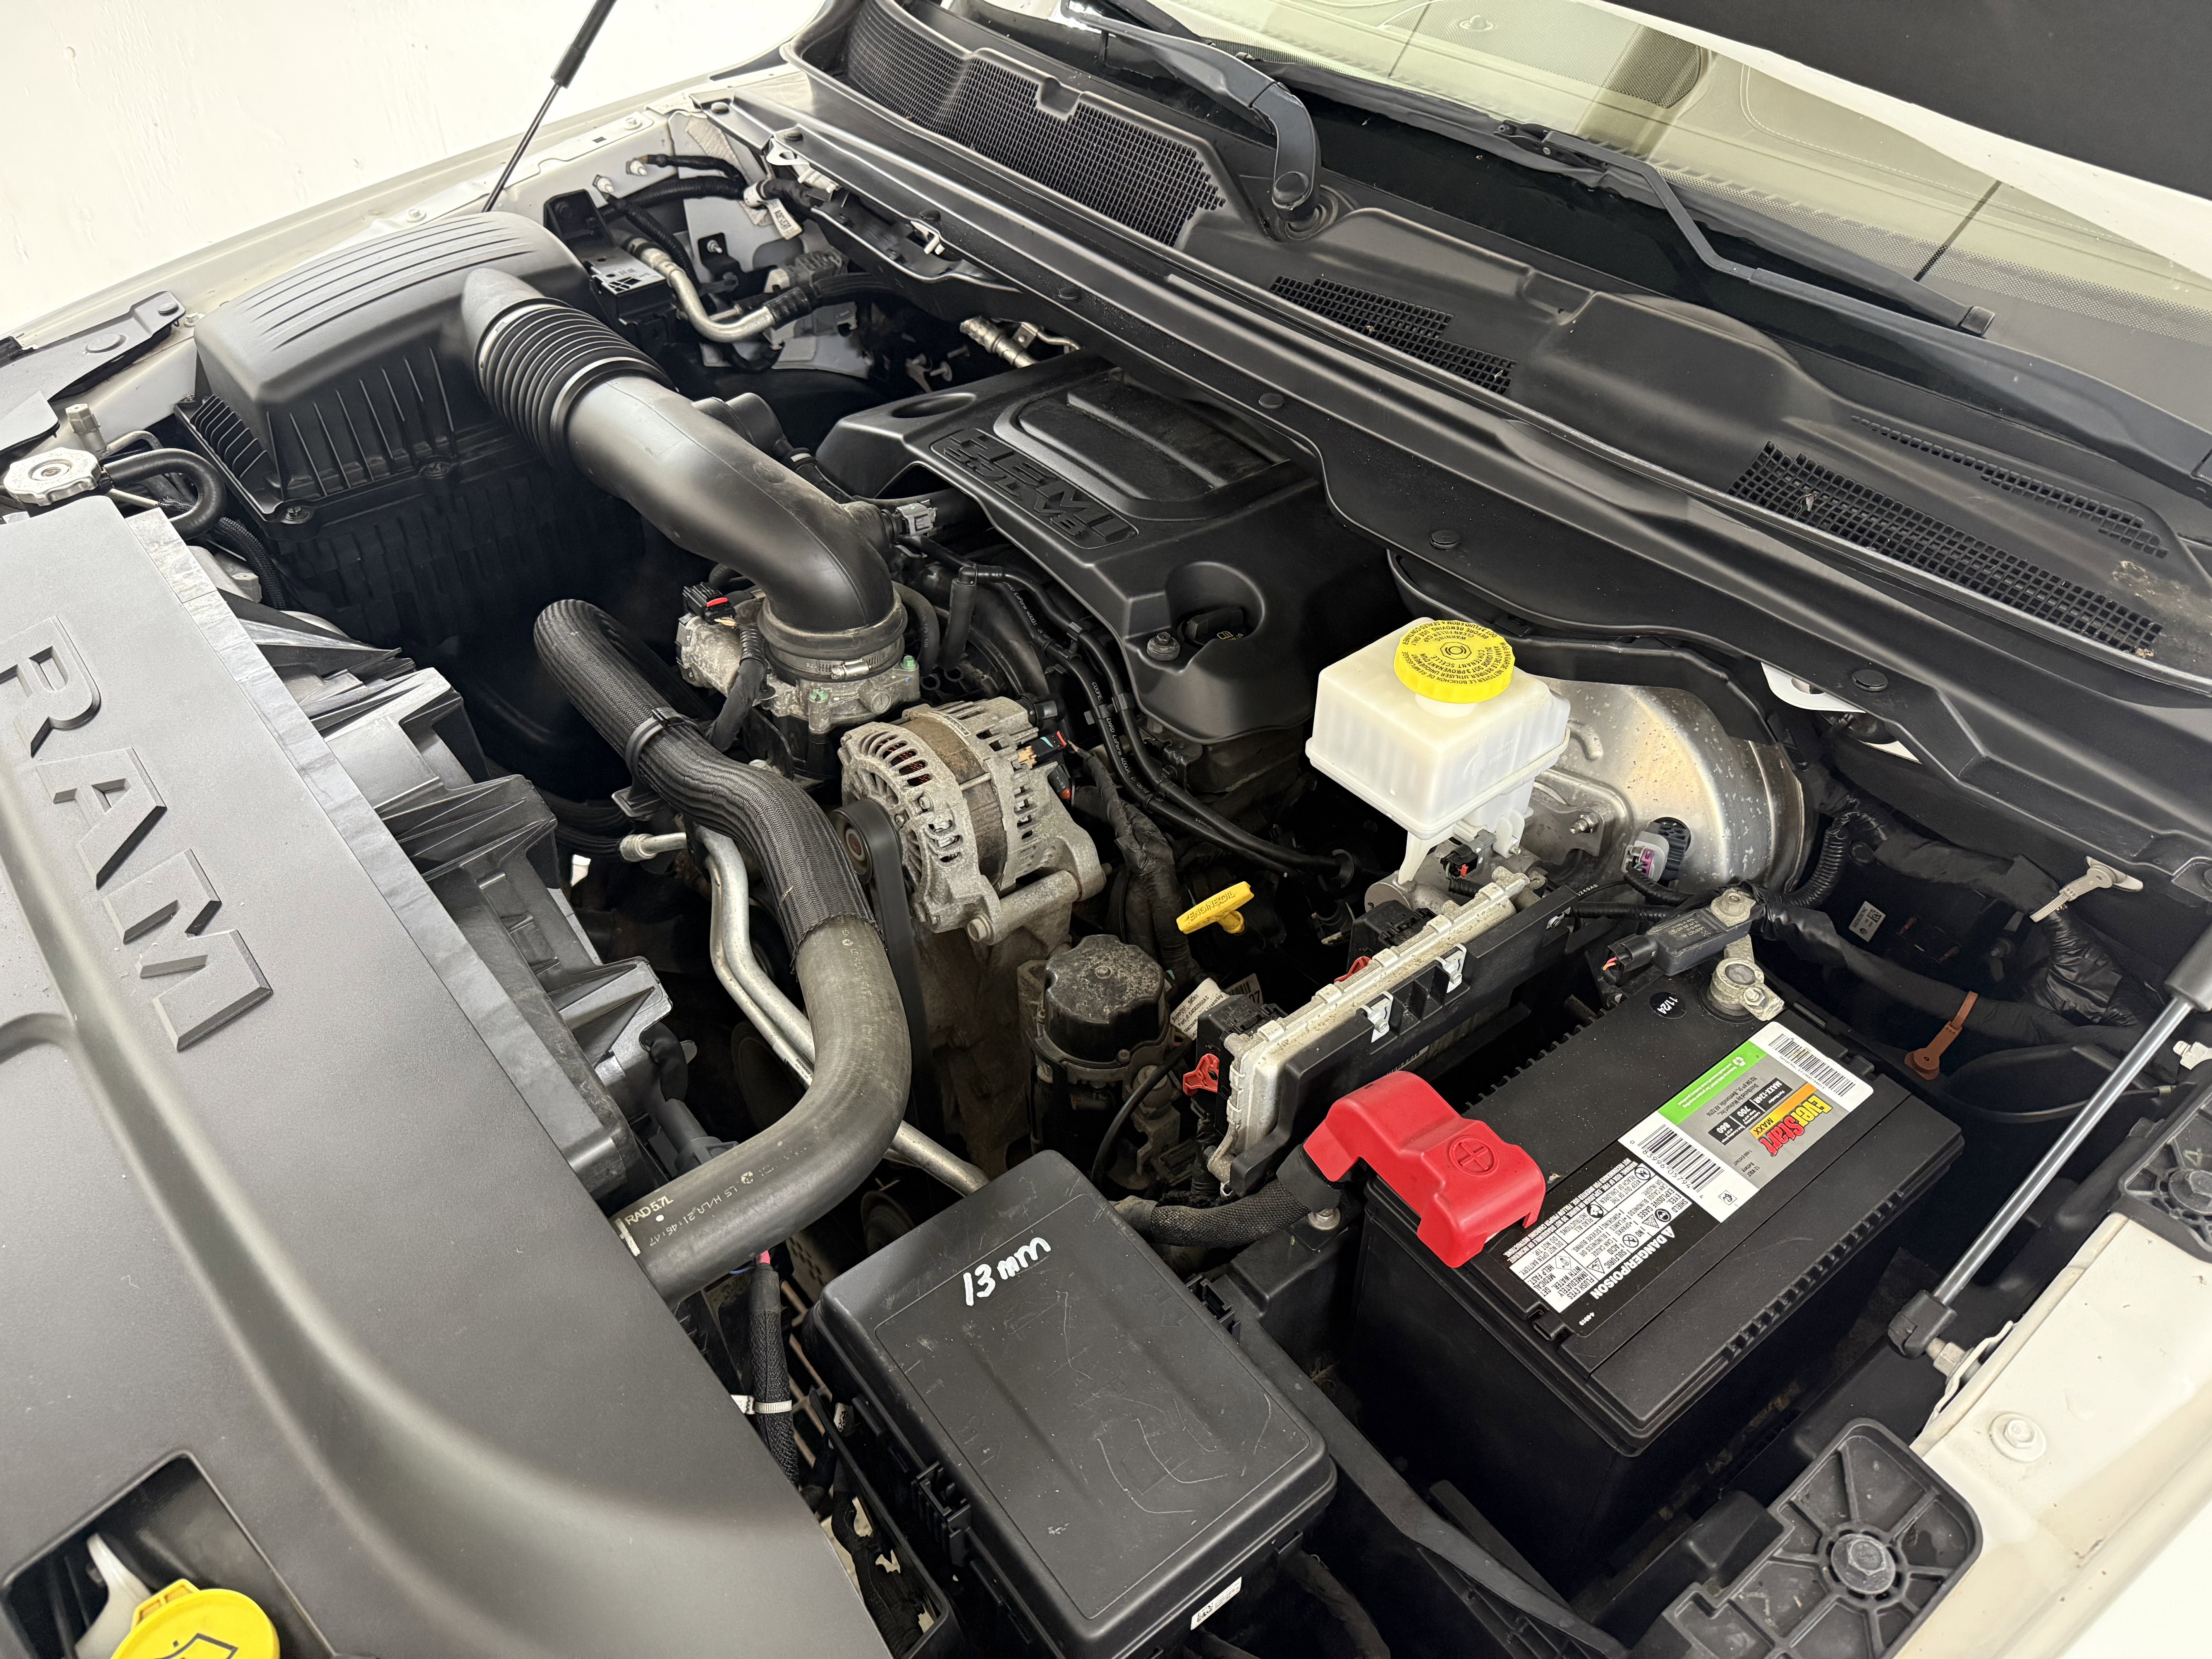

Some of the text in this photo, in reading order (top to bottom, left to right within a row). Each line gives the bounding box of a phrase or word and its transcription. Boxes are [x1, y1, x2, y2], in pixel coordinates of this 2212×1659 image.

[950, 428, 1131, 539] HEMI
[1465, 622, 1482, 630] FLUID
[1465, 628, 1489, 639] BEFORE
[1401, 627, 1421, 644] CONTAINER
[1410, 636, 1420, 646] ONLY
[1411, 654, 1439, 675] UNIQUEMENT
[1427, 661, 1465, 673] PROVENANT
[1458, 649, 1485, 668] CONTENANT
[1477, 669, 1504, 682] NETTOYER
[1091, 680, 1104, 702] COOPE
[0, 615, 273, 1051] RAM
[1187, 891, 1236, 921] ENGINE OIL
[1657, 996, 1678, 1014] 11/24
[1740, 1083, 1759, 1098] Distributed
[1752, 1080, 1783, 1104] MAXX-124R
[1723, 1099, 1740, 1112] Walmart
[1735, 1105, 1752, 1118] 700
[1715, 1121, 1731, 1134] 860
[1752, 1117, 1775, 1135] MAXX
[1756, 1094, 1834, 1157] EverStart
[1598, 1162, 1625, 1184] RECOMMENDED
[1642, 1149, 1667, 1169] 83996
[1667, 1168, 1692, 1188] 05794
[1740, 1161, 1755, 1173] Battery
[1591, 1180, 1602, 1189] FOR
[1612, 1173, 1623, 1182] RISK
[1621, 1174, 1636, 1186] REACH
[1629, 1179, 1642, 1189] KEEP
[1582, 1188, 1603, 1205] EXPLOSION
[1622, 1186, 1633, 1195] OUT
[1640, 1183, 1657, 1197] INJURY.
[1609, 1196, 1620, 1204] THE
[1626, 1183, 1668, 1216] CAN CAUSE BLINDNESS
[1636, 1187, 1675, 1219] EXPLOSIVE GASES
[1666, 1193, 1682, 1206] EYES.
[1670, 1198, 1688, 1213] SHIELD
[624, 1207, 653, 1226] RAD
[1543, 1213, 1560, 1227] PROPER
[1553, 1219, 1564, 1228] NOT
[1558, 1212, 1588, 1237] INSTRUCTIONS.
[1573, 1216, 1594, 1233] READ ALL
[1527, 1223, 1547, 1240] CHARGING
[1531, 1224, 1557, 1245] DISASSEMBLE
[1634, 1229, 1645, 1237] NO
[1532, 1235, 1558, 1257] DO NOT TIP.
[1546, 1245, 1558, 1254] NOT
[1570, 1228, 1602, 1254] SEVERE BURNS.
[1584, 1233, 1608, 1252] BLINDNESS
[1590, 1238, 1614, 1257] CAN CAUSE
[1606, 1243, 1621, 1255] ACID
[1536, 1251, 1549, 1262] OPEN
[1602, 1249, 1628, 1269] SULFURIC
[963, 1237, 1051, 1306] 13 mm
[1518, 1259, 1539, 1276] BATTERY.
[1527, 1263, 1554, 1286] HELP FAST.
[1588, 1233, 1668, 1300] DANGER/POISON
[1533, 1273, 1556, 1291] MEDICAL
[1550, 1265, 1582, 1291] WITH WATER.
[1556, 1270, 1589, 1297] IMMEDIATELY
[1539, 1286, 1551, 1297] GET
[1566, 1276, 1595, 1300] FLUSH EYES
